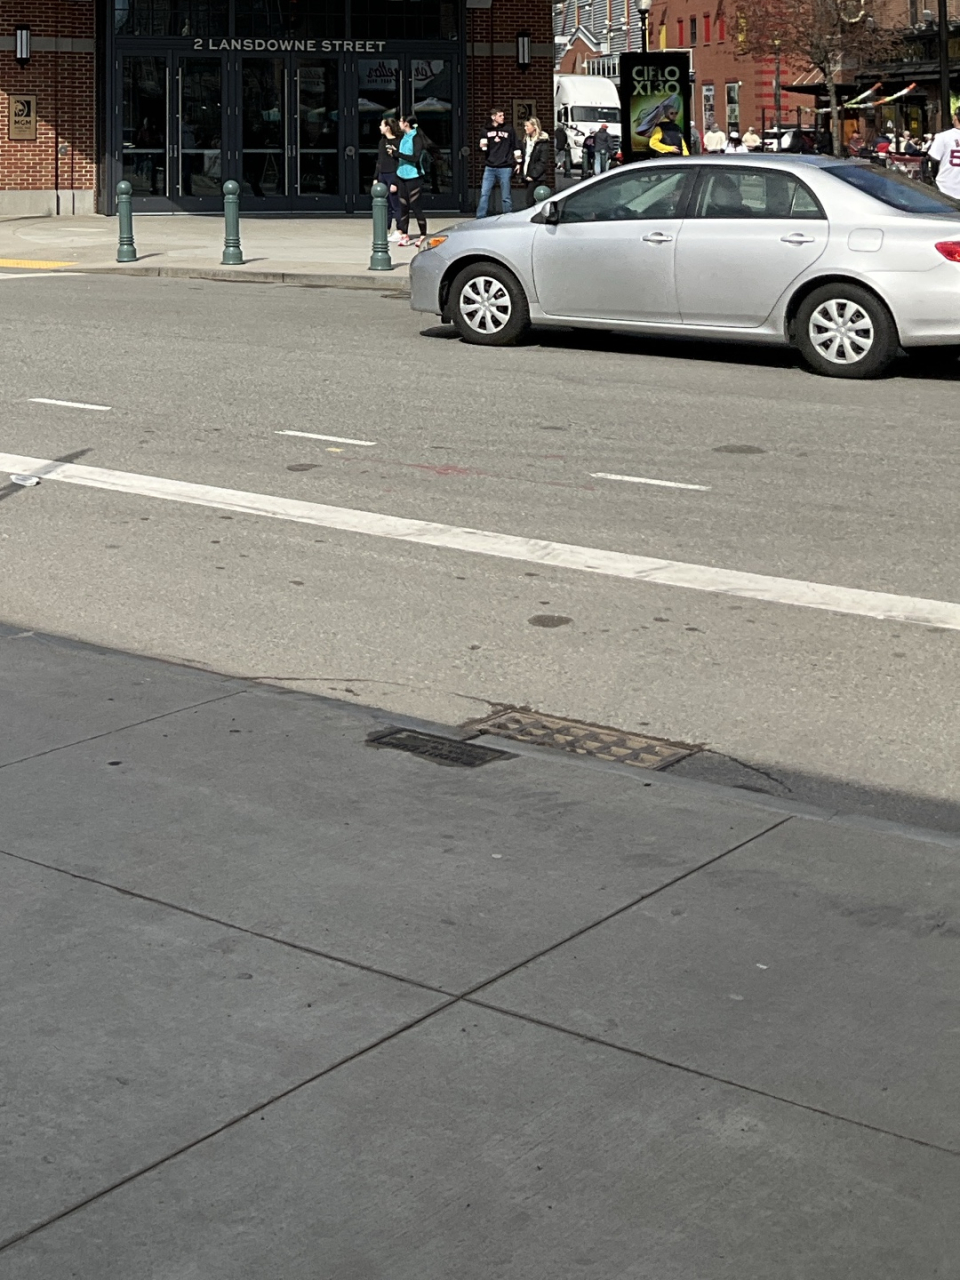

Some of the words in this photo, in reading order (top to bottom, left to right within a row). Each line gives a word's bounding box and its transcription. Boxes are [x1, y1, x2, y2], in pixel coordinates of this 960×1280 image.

[193, 38, 203, 50] 2
[209, 39, 317, 51] LANSDOWNE
[321, 40, 386, 52] STREET
[632, 66, 680, 81] CIELO
